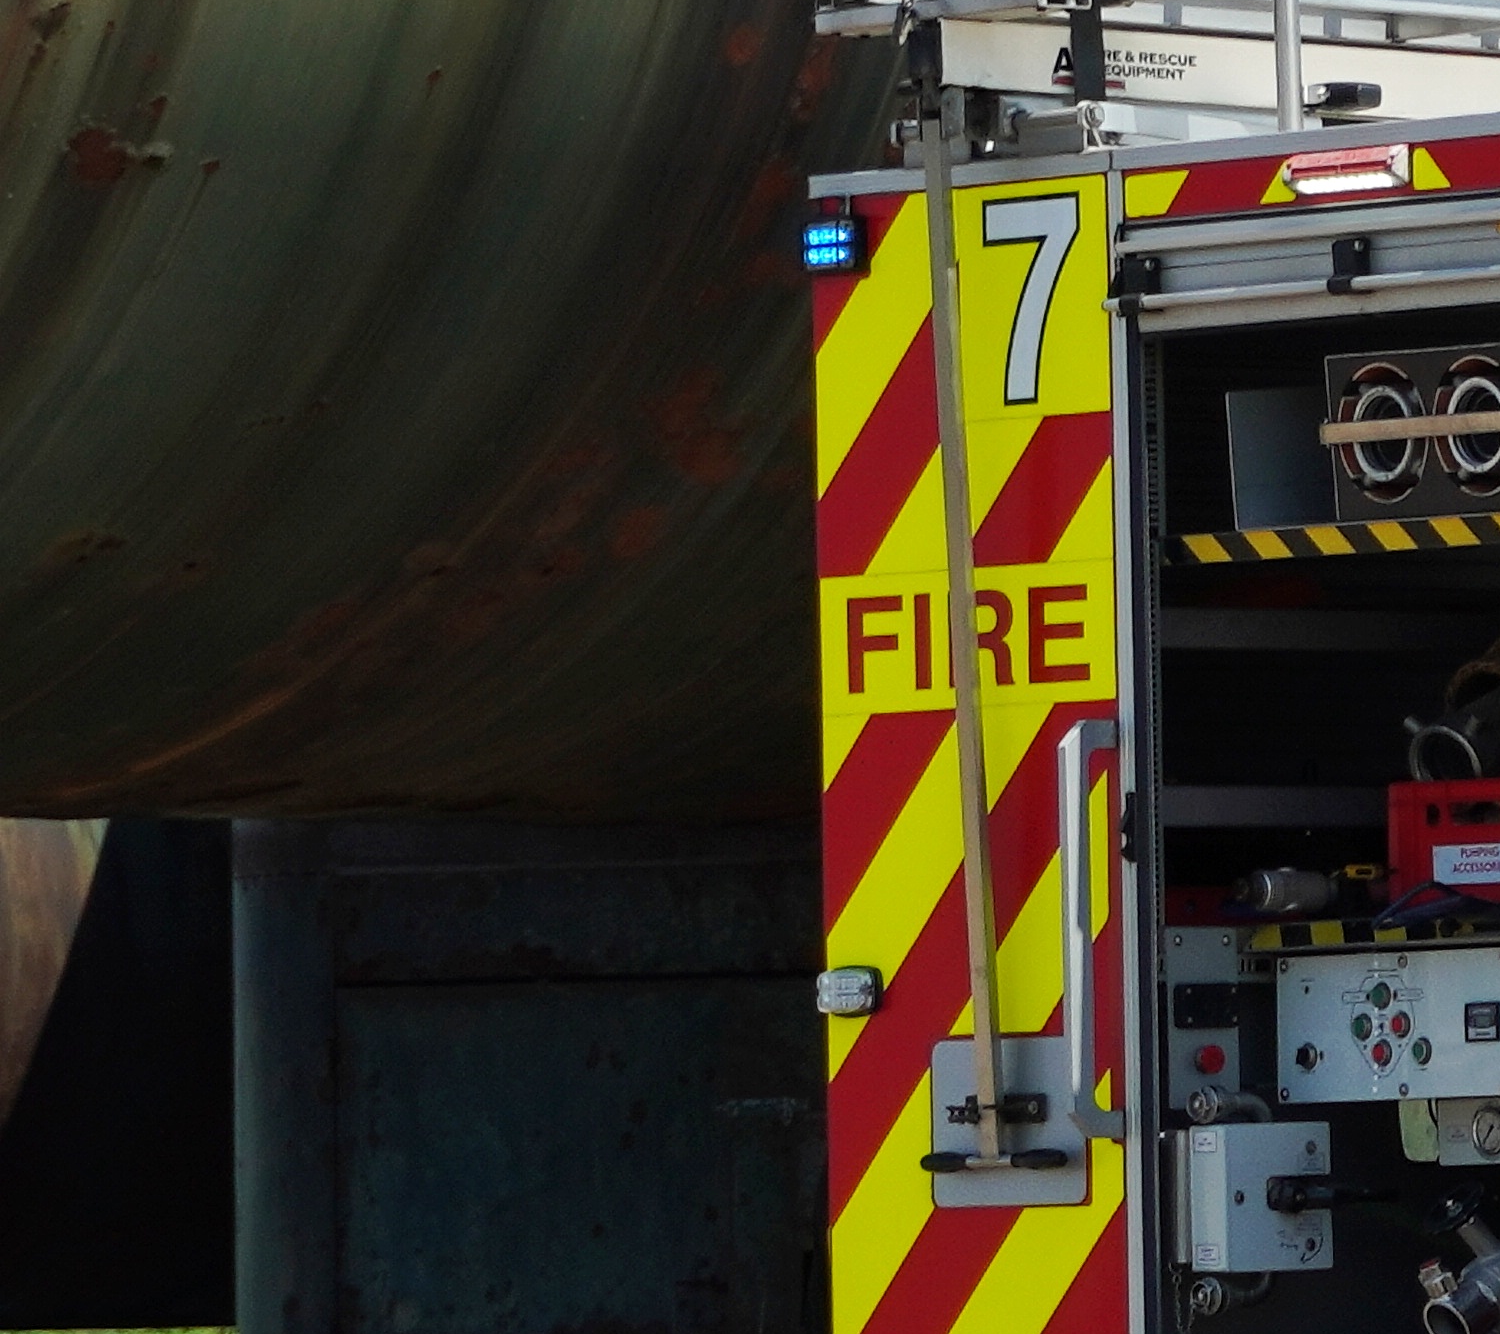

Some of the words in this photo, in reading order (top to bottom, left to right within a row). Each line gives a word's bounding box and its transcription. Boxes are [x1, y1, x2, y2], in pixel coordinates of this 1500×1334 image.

[1139, 51, 1197, 67] RESCUE
[982, 191, 1080, 405] 7
[846, 583, 1092, 694] FIRE
